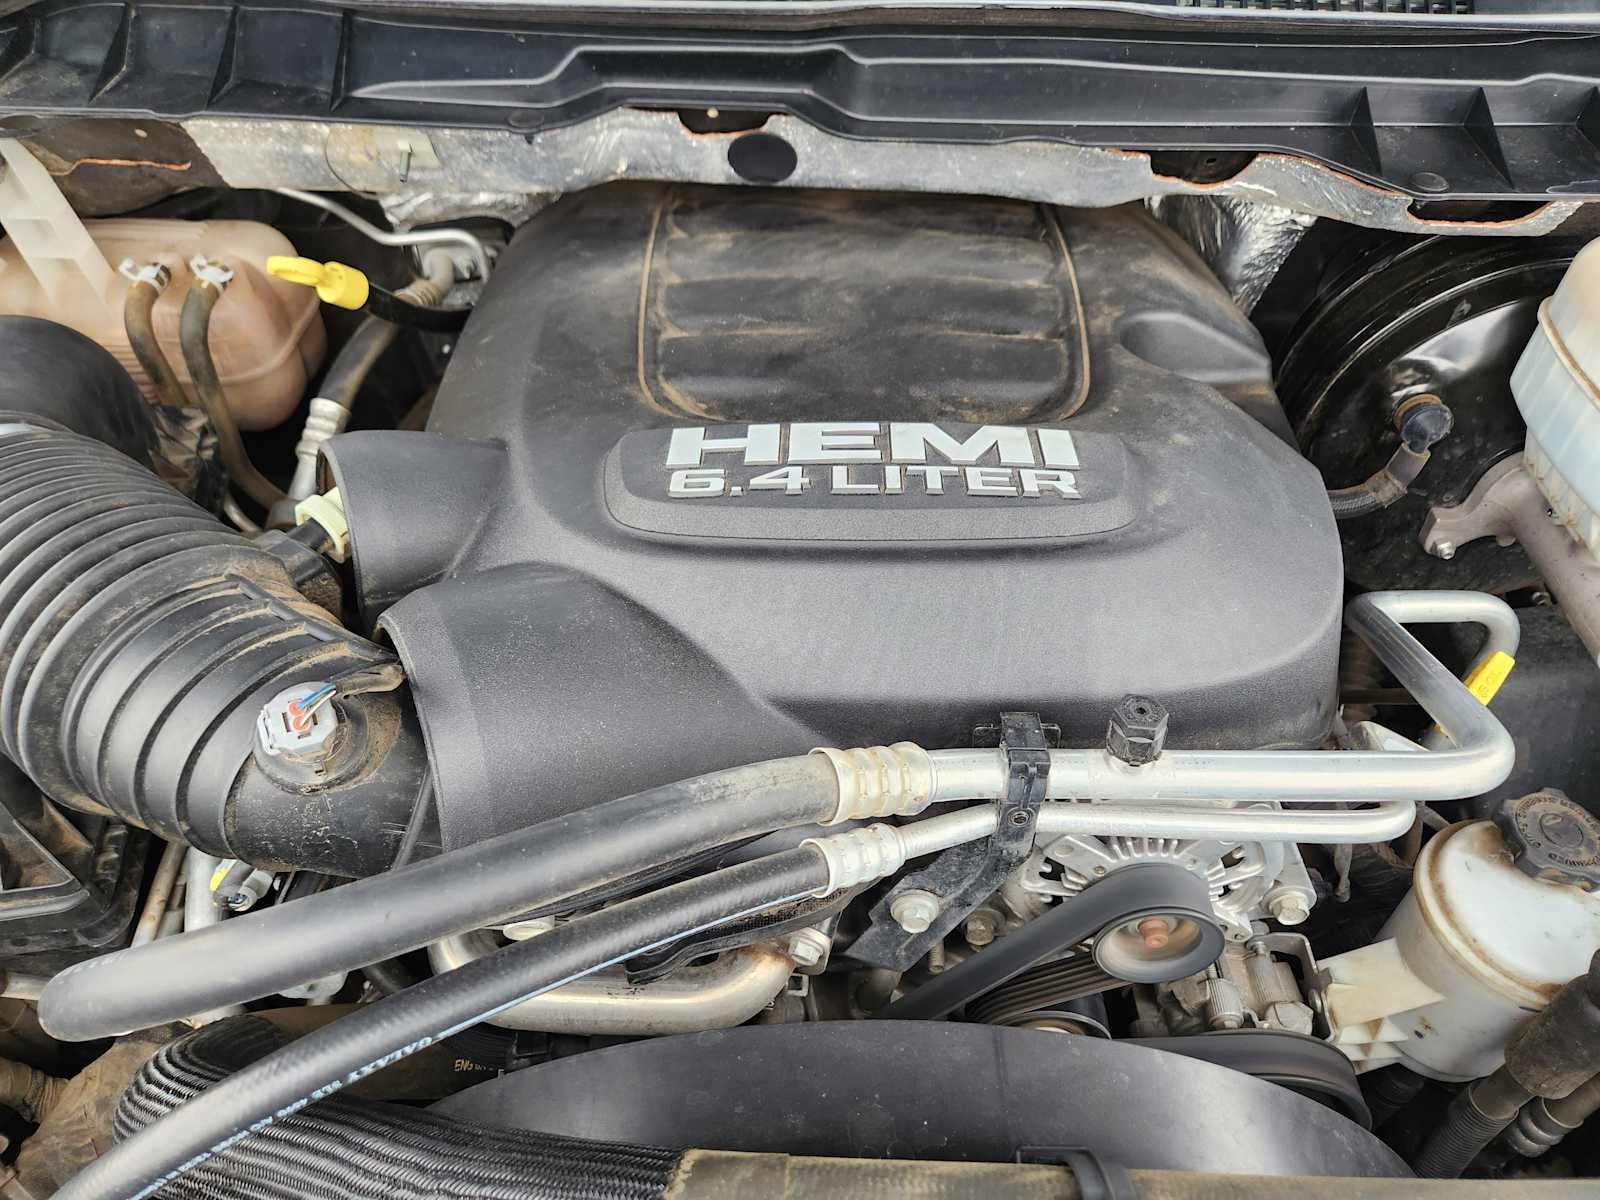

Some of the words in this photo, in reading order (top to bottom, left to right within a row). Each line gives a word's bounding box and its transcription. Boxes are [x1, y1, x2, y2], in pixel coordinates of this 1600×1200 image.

[666, 422, 1081, 470] HEMI
[668, 466, 811, 498] 6.4
[830, 465, 1082, 499] LITER
